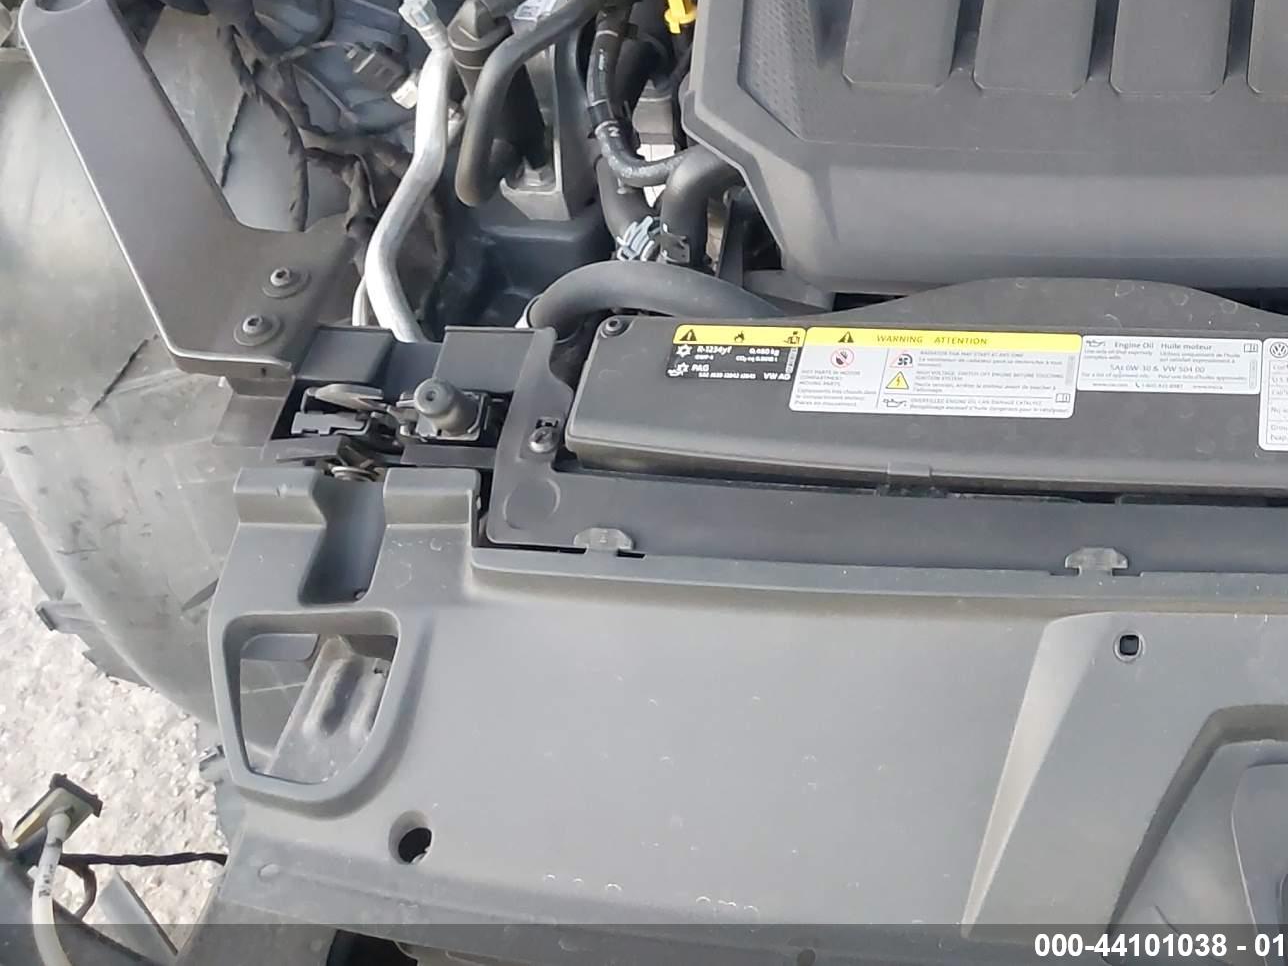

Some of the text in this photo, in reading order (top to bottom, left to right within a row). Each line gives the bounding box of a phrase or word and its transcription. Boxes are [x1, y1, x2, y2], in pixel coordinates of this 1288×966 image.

[876, 335, 988, 346] WARNING ATTENTION
[696, 345, 732, 355] R-1234yf
[1114, 342, 1141, 350] Engine
[690, 364, 710, 372] PAG
[764, 372, 778, 380] VW
